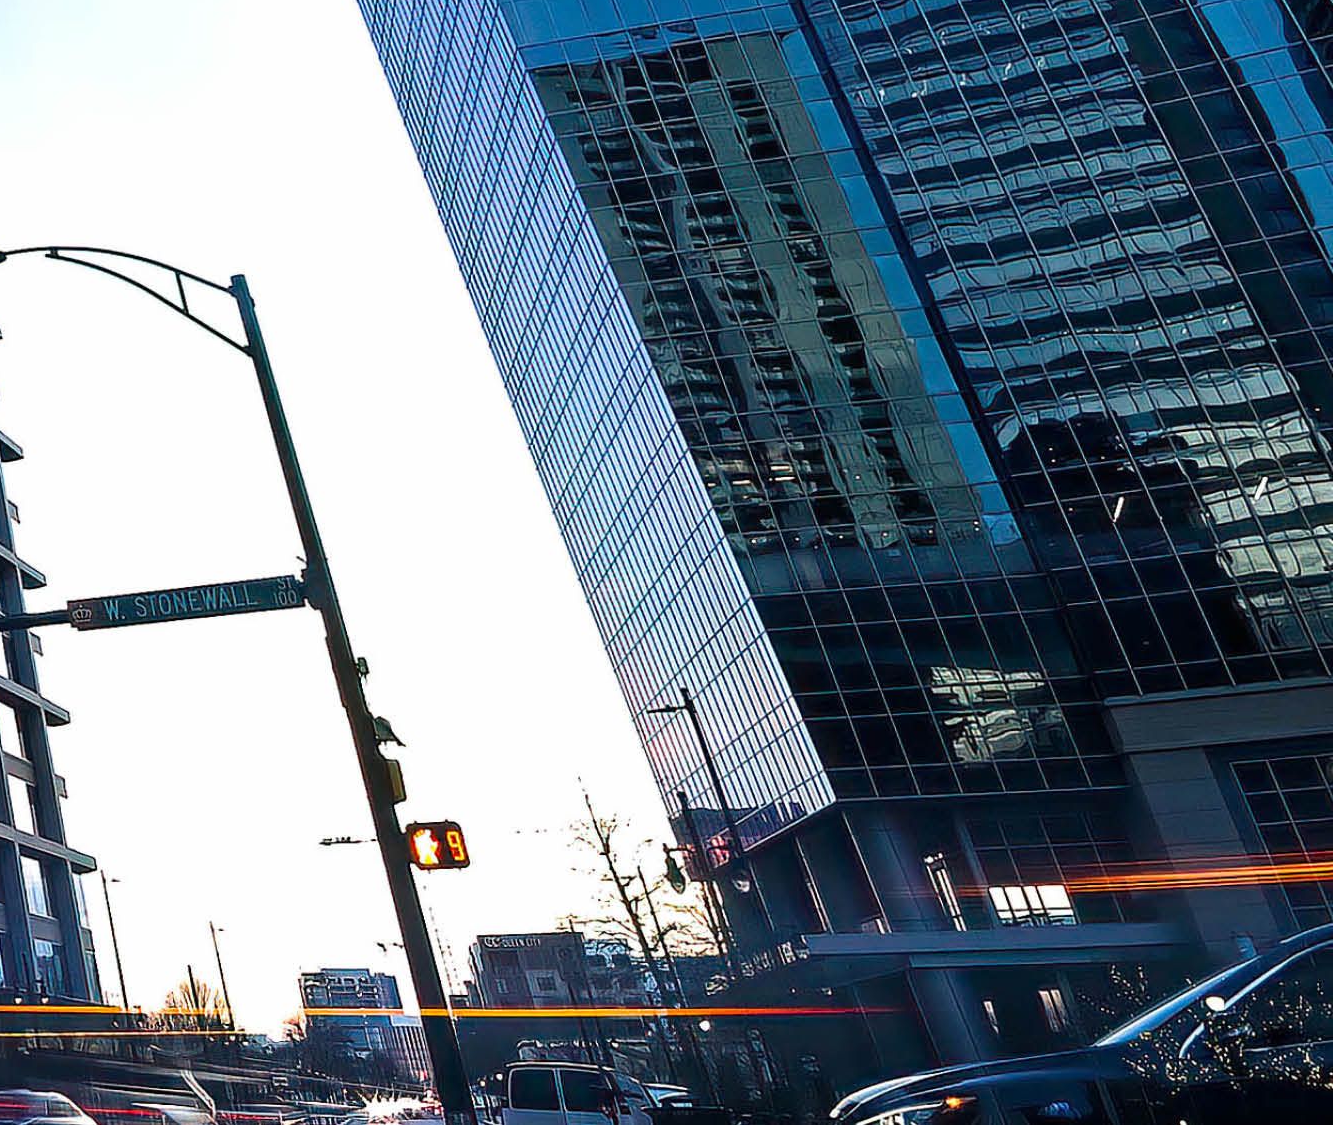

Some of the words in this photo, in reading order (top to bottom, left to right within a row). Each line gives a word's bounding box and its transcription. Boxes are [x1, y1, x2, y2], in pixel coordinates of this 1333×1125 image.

[104, 599, 126, 620] W.
[136, 584, 258, 618] STONEWALL
[277, 577, 293, 590] ST
[274, 590, 297, 605] 100
[447, 830, 465, 861] 9
